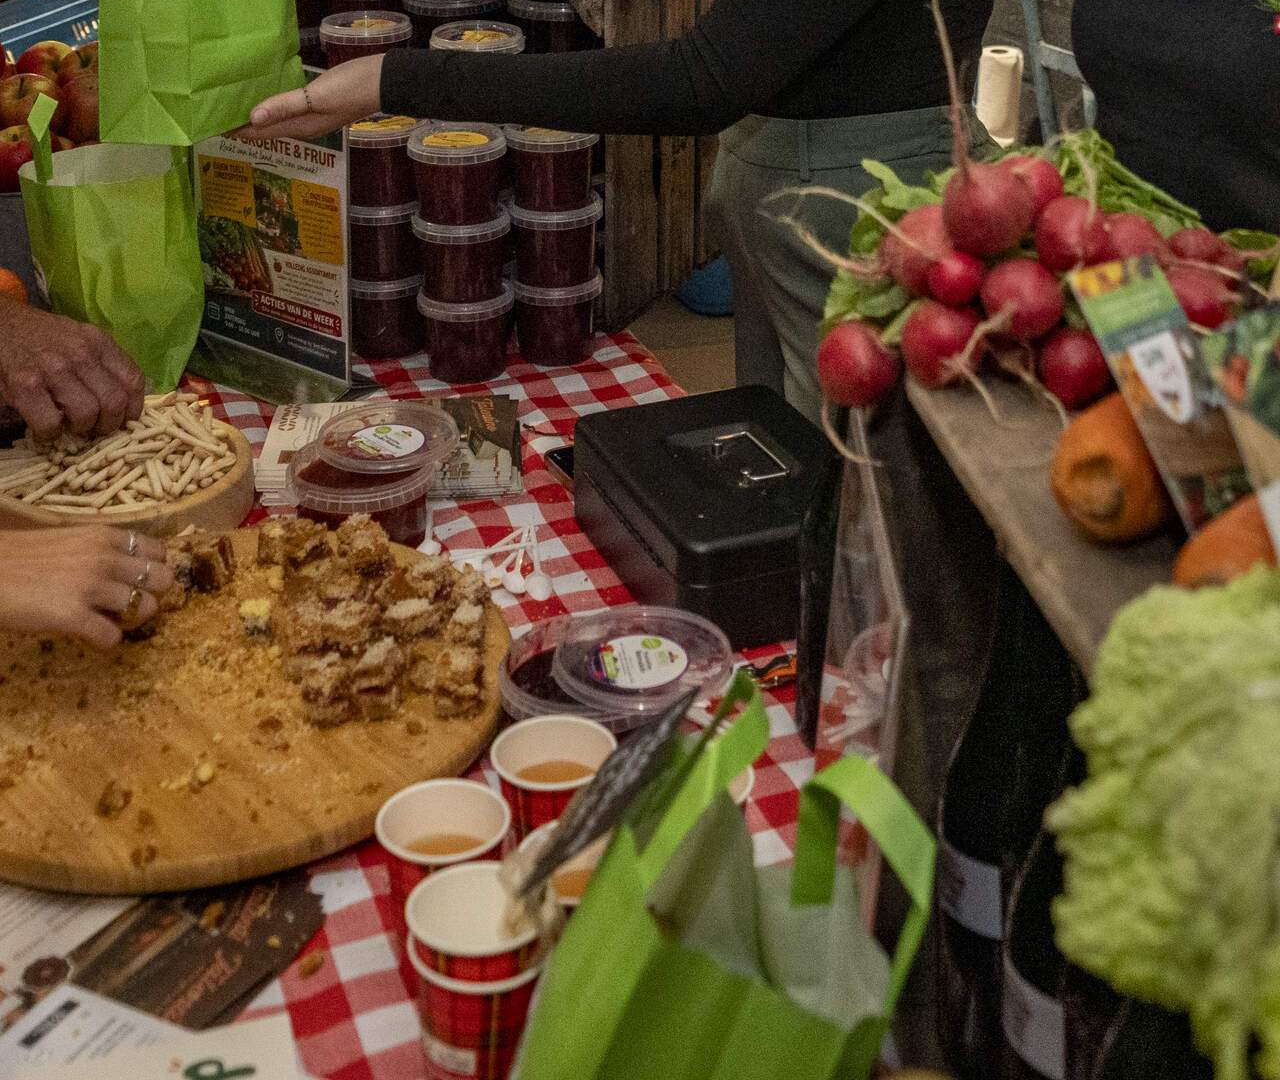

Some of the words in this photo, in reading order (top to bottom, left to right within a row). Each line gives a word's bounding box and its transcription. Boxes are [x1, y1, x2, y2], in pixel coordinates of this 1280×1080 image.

[293, 144, 301, 159] &
[304, 146, 336, 168] FRUIT
[260, 295, 285, 309] ACTIES
[287, 304, 301, 316] VAN
[302, 309, 313, 320] DE
[314, 312, 335, 327] WEEK
